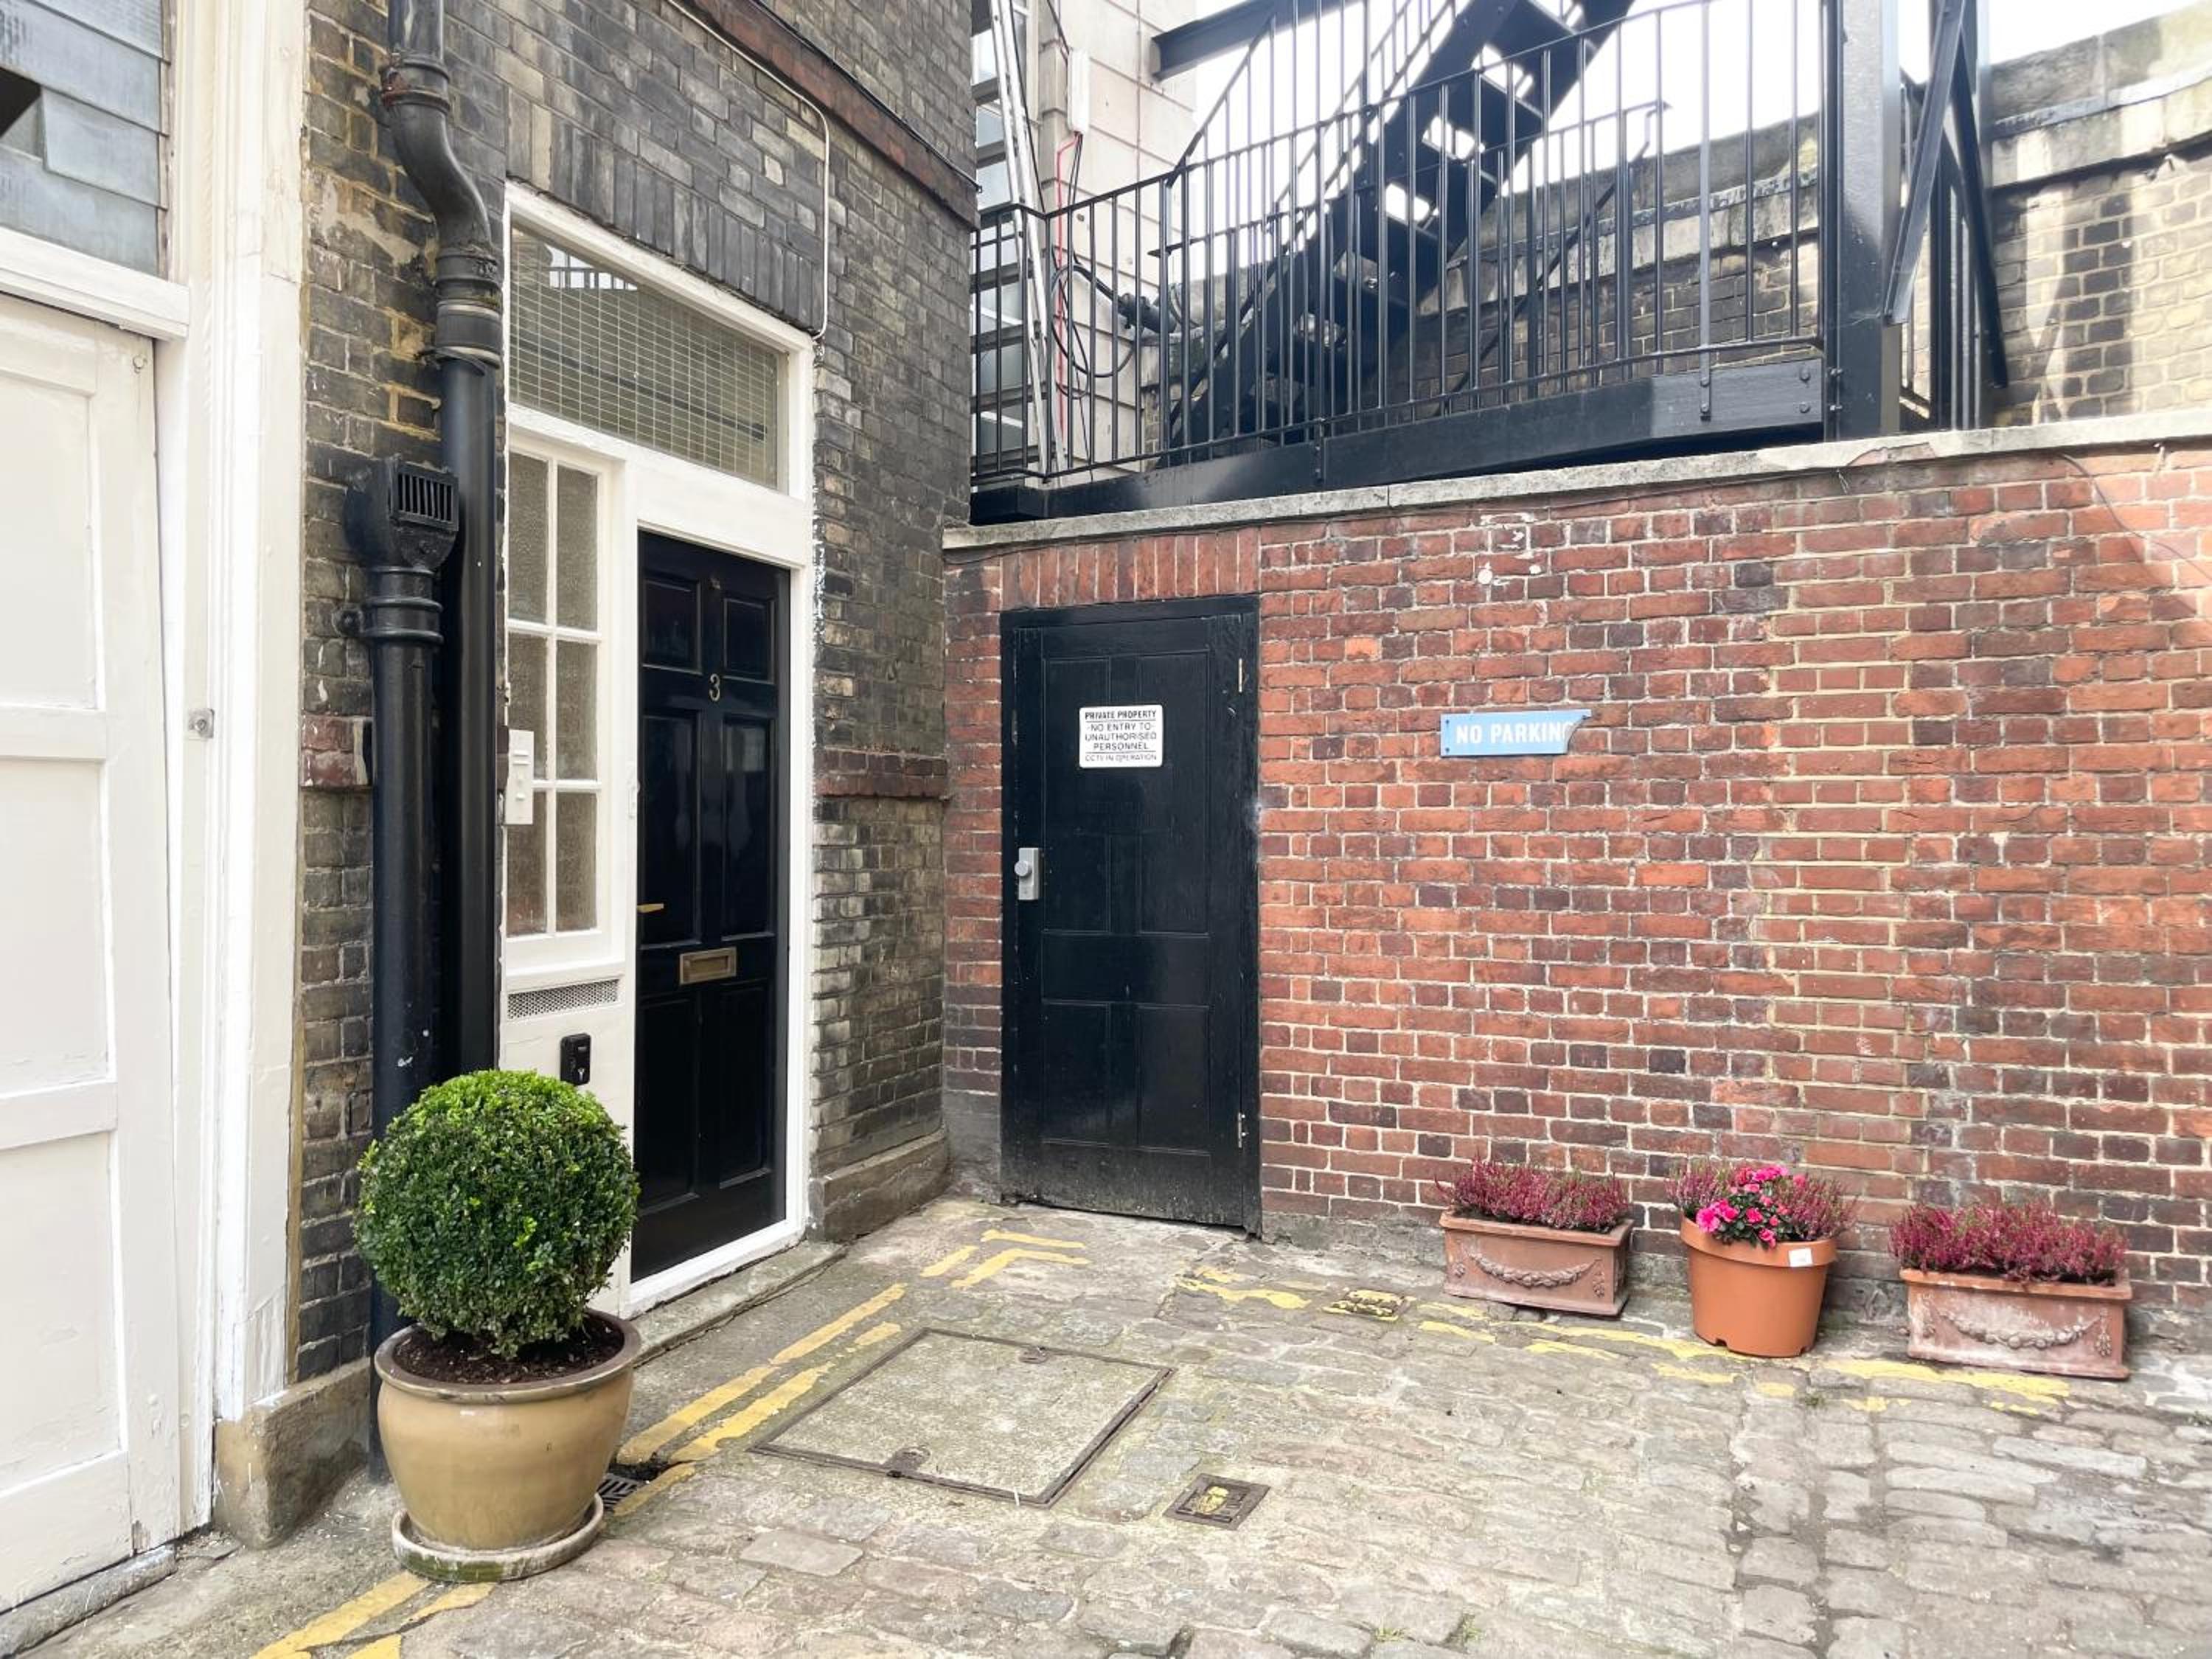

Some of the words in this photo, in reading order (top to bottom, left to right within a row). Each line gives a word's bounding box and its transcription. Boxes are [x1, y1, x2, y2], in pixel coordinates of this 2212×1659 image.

[709, 673, 720, 702] 3
[1085, 712, 1115, 720] PRIVATE
[1117, 710, 1157, 719] PROPERTY
[1107, 723, 1136, 731] ENTRY
[1455, 724, 1482, 744] NO
[1093, 742, 1150, 751] PERSONNEL
[1116, 754, 1157, 762] OPERATION
